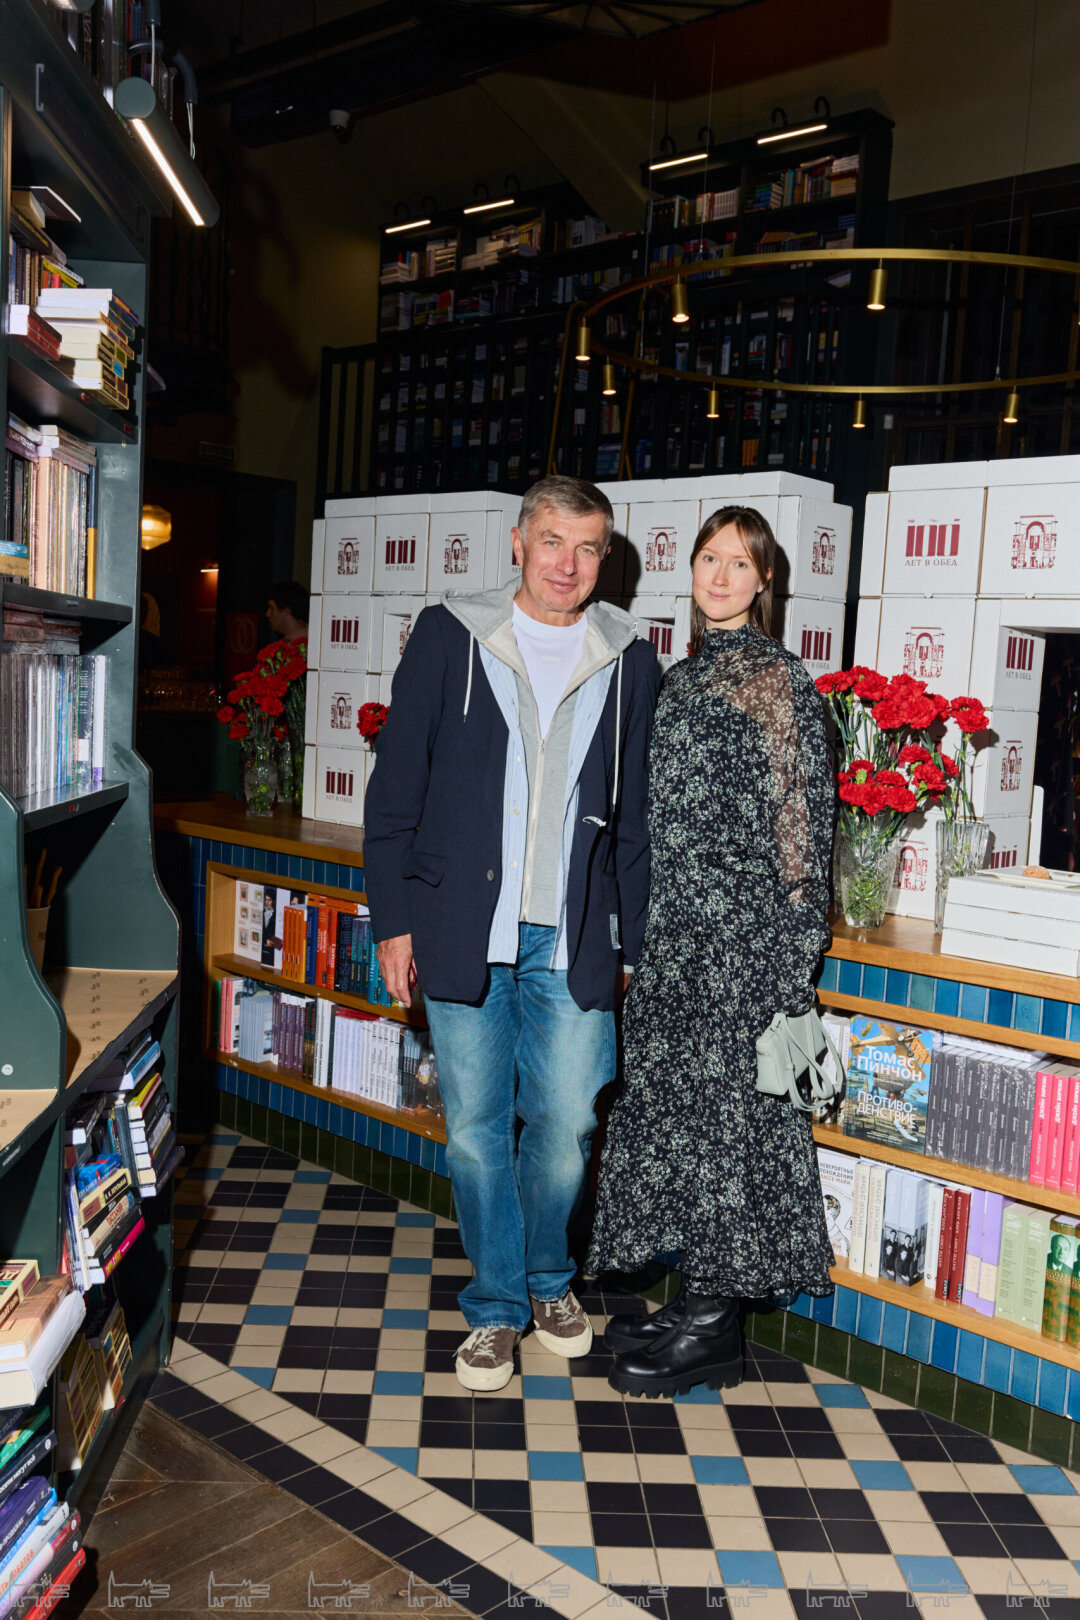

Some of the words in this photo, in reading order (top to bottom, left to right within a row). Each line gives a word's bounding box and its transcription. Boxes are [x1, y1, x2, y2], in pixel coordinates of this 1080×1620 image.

[905, 559, 921, 567] ЛЕТ
[925, 559, 930, 567] В
[933, 558, 958, 567] ОБЕД
[857, 1055, 923, 1082] Пинчон
[865, 1045, 915, 1069] Томас
